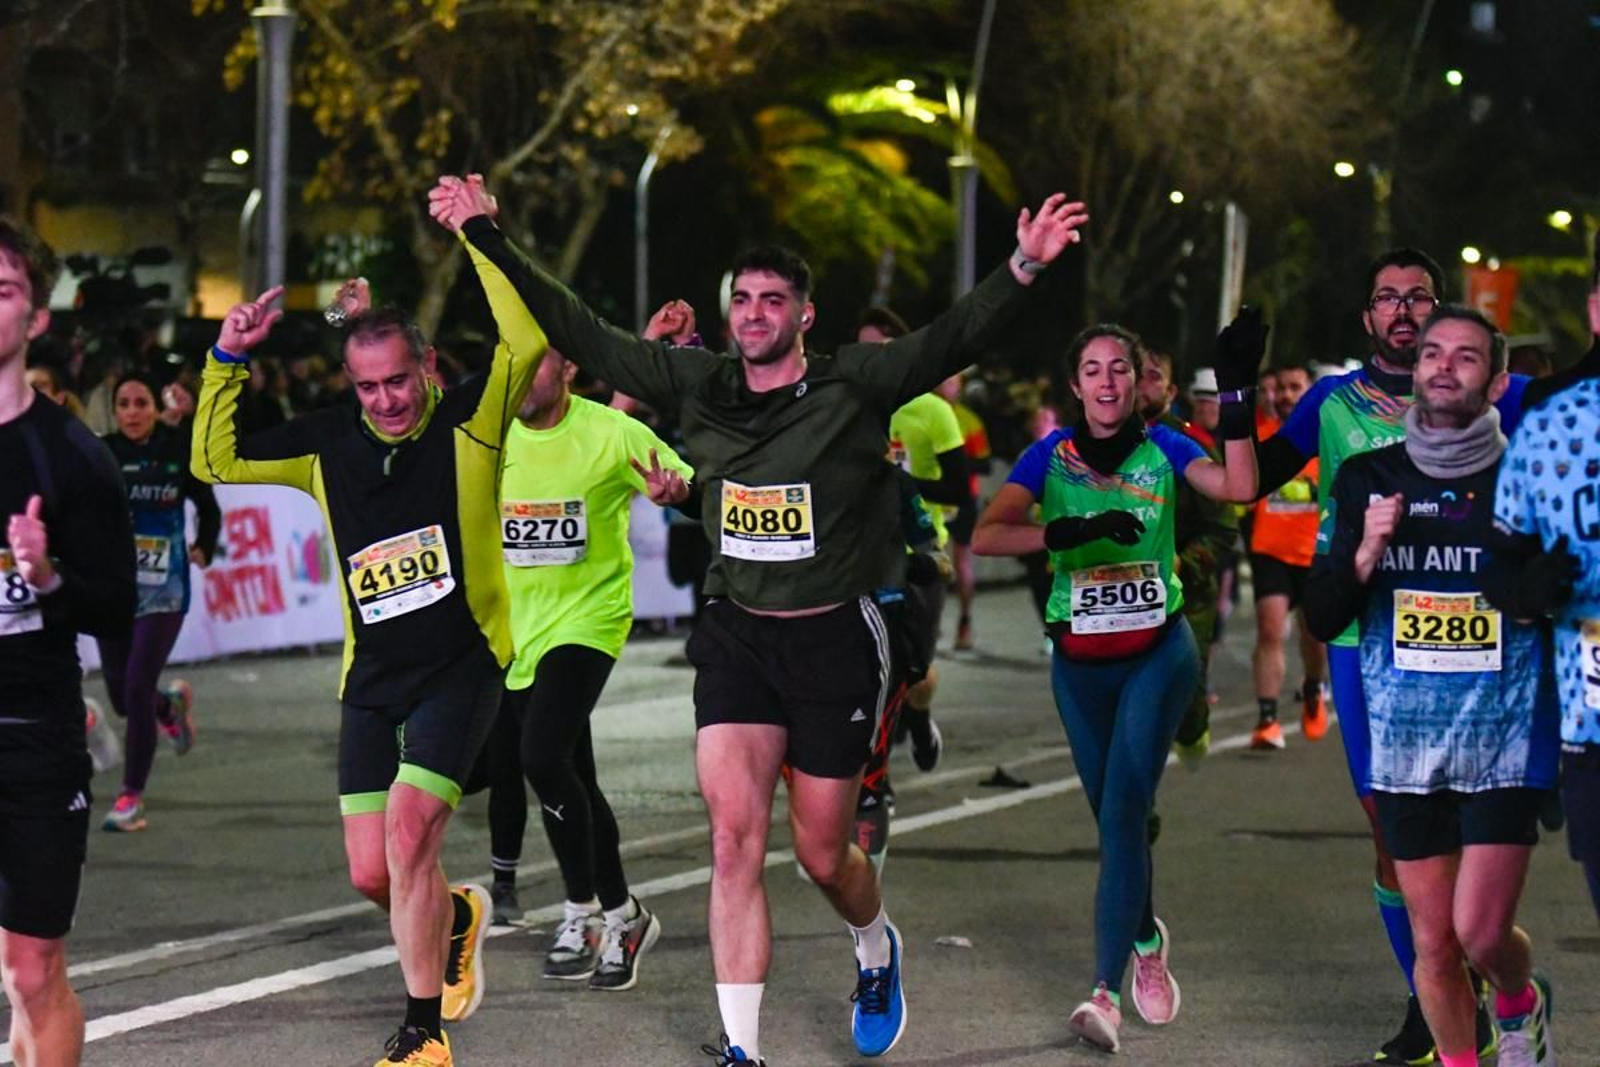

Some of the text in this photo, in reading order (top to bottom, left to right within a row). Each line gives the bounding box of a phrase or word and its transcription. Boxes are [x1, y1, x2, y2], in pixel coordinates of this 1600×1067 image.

[504, 518, 579, 541] 6270
[726, 505, 802, 533] 4080
[360, 550, 440, 592] 4190
[1377, 545, 1483, 573] AN ANT
[1080, 580, 1158, 608] 5506
[1402, 614, 1490, 642] 3280
